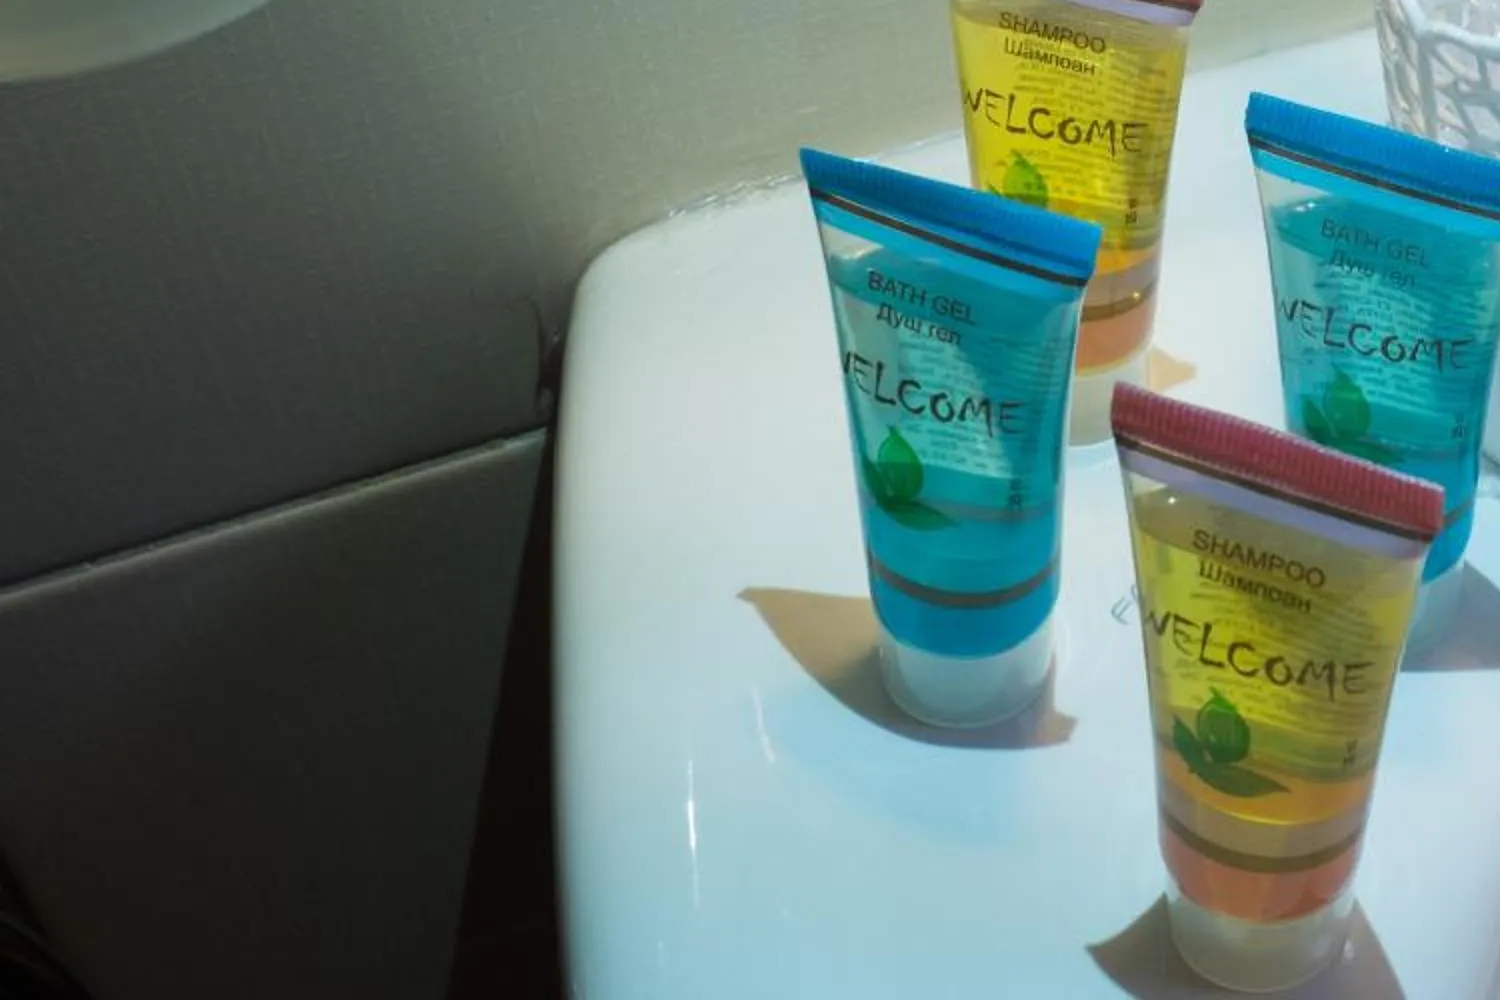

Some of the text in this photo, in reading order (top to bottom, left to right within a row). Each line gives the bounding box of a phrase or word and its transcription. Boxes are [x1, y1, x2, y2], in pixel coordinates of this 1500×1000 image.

[998, 10, 1107, 55] SHAMPOO
[1003, 36, 1098, 77] Шампоан
[1320, 218, 1430, 270] BATH GEL
[867, 269, 977, 327] BATH GEL
[876, 300, 923, 334] Душ
[841, 350, 1026, 438] ELCOME
[1192, 528, 1327, 589] SHAMPOO
[1198, 558, 1312, 614] Шампоан
